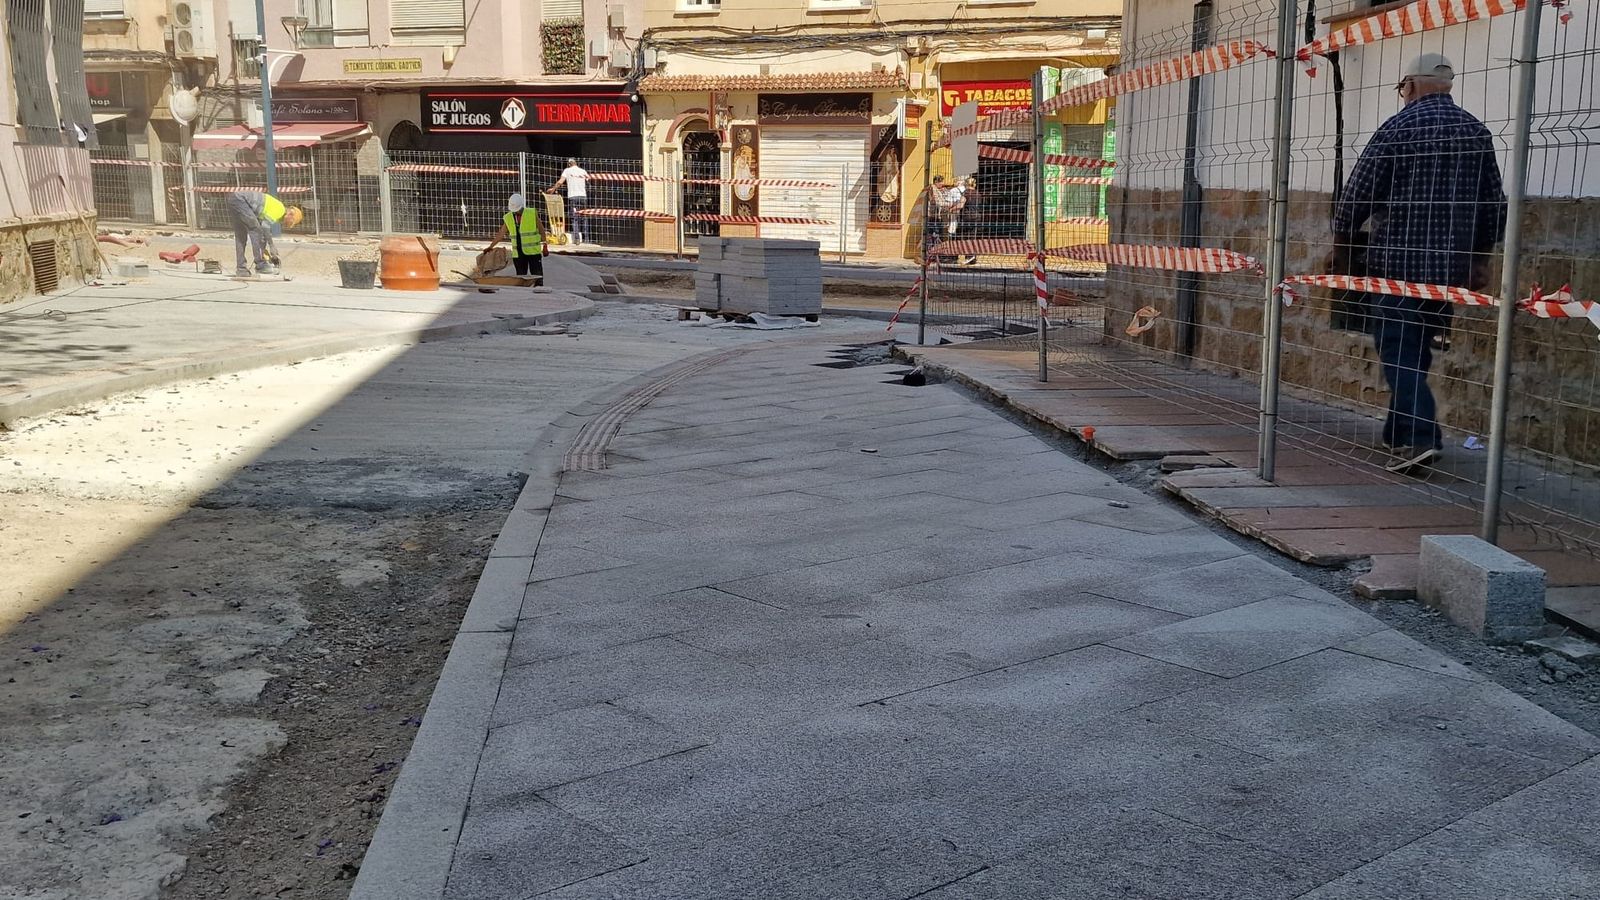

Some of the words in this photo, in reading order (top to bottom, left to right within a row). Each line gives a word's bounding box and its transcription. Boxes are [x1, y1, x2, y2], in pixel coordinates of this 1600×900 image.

[349, 62, 374, 71] TENIENTE
[90, 98, 110, 106] hop
[431, 98, 467, 113] SALÓN
[288, 103, 323, 114] Solano
[536, 103, 631, 123] TERRAMAR
[432, 113, 447, 125] DE
[449, 113, 492, 125] JUEGOS
